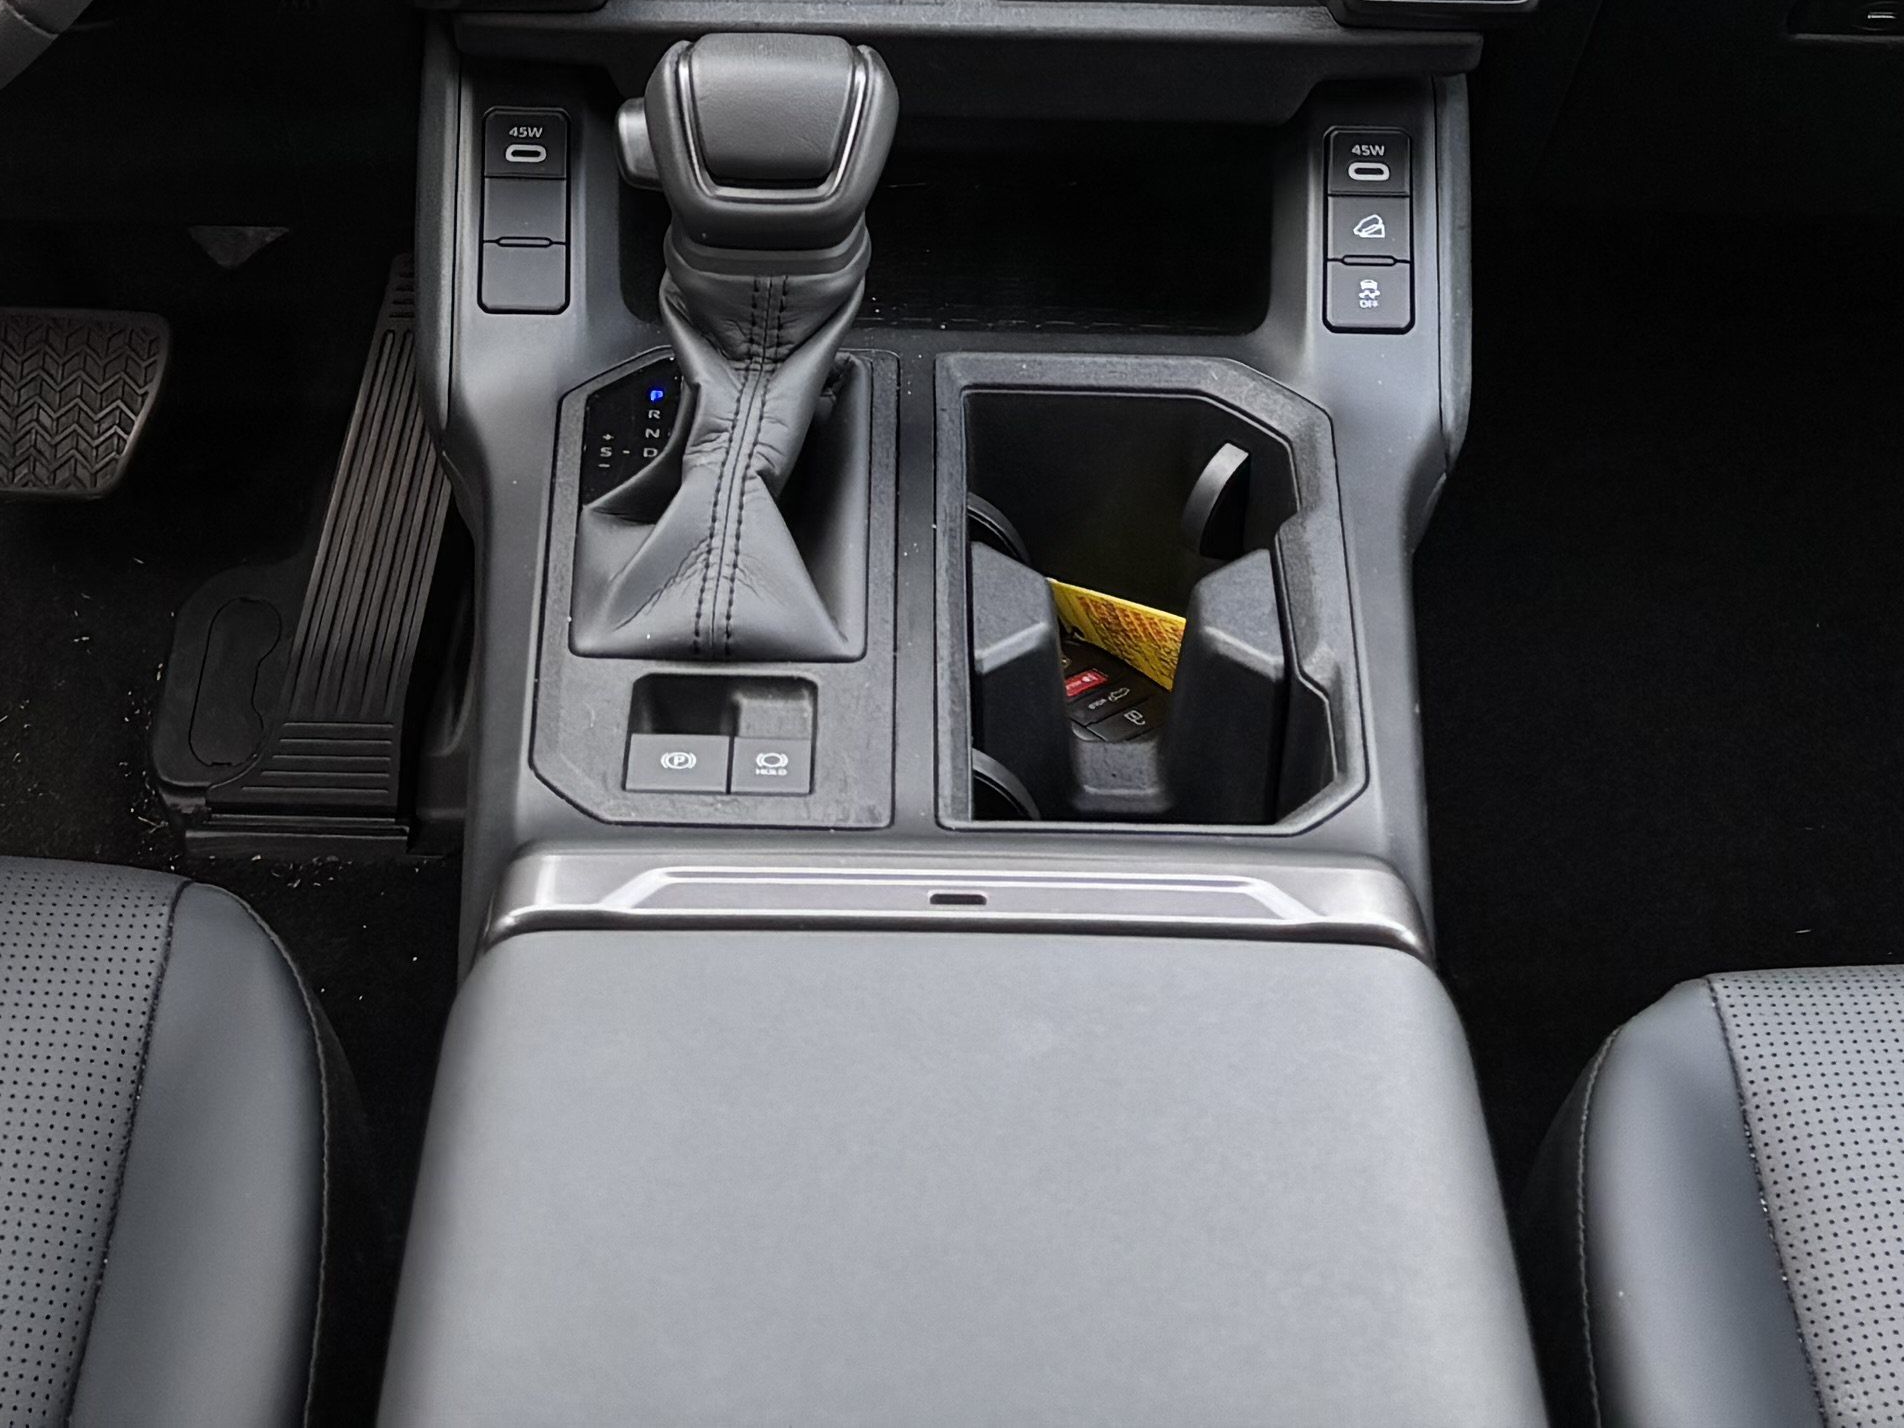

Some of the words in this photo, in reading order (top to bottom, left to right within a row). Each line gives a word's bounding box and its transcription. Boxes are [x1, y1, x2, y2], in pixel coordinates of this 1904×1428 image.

[509, 126, 543, 139] 45W
[1351, 144, 1385, 157] 45W
[650, 390, 664, 402] P
[648, 409, 661, 420] R
[645, 428, 660, 439] N
[600, 446, 613, 458] S
[643, 447, 658, 458] D
